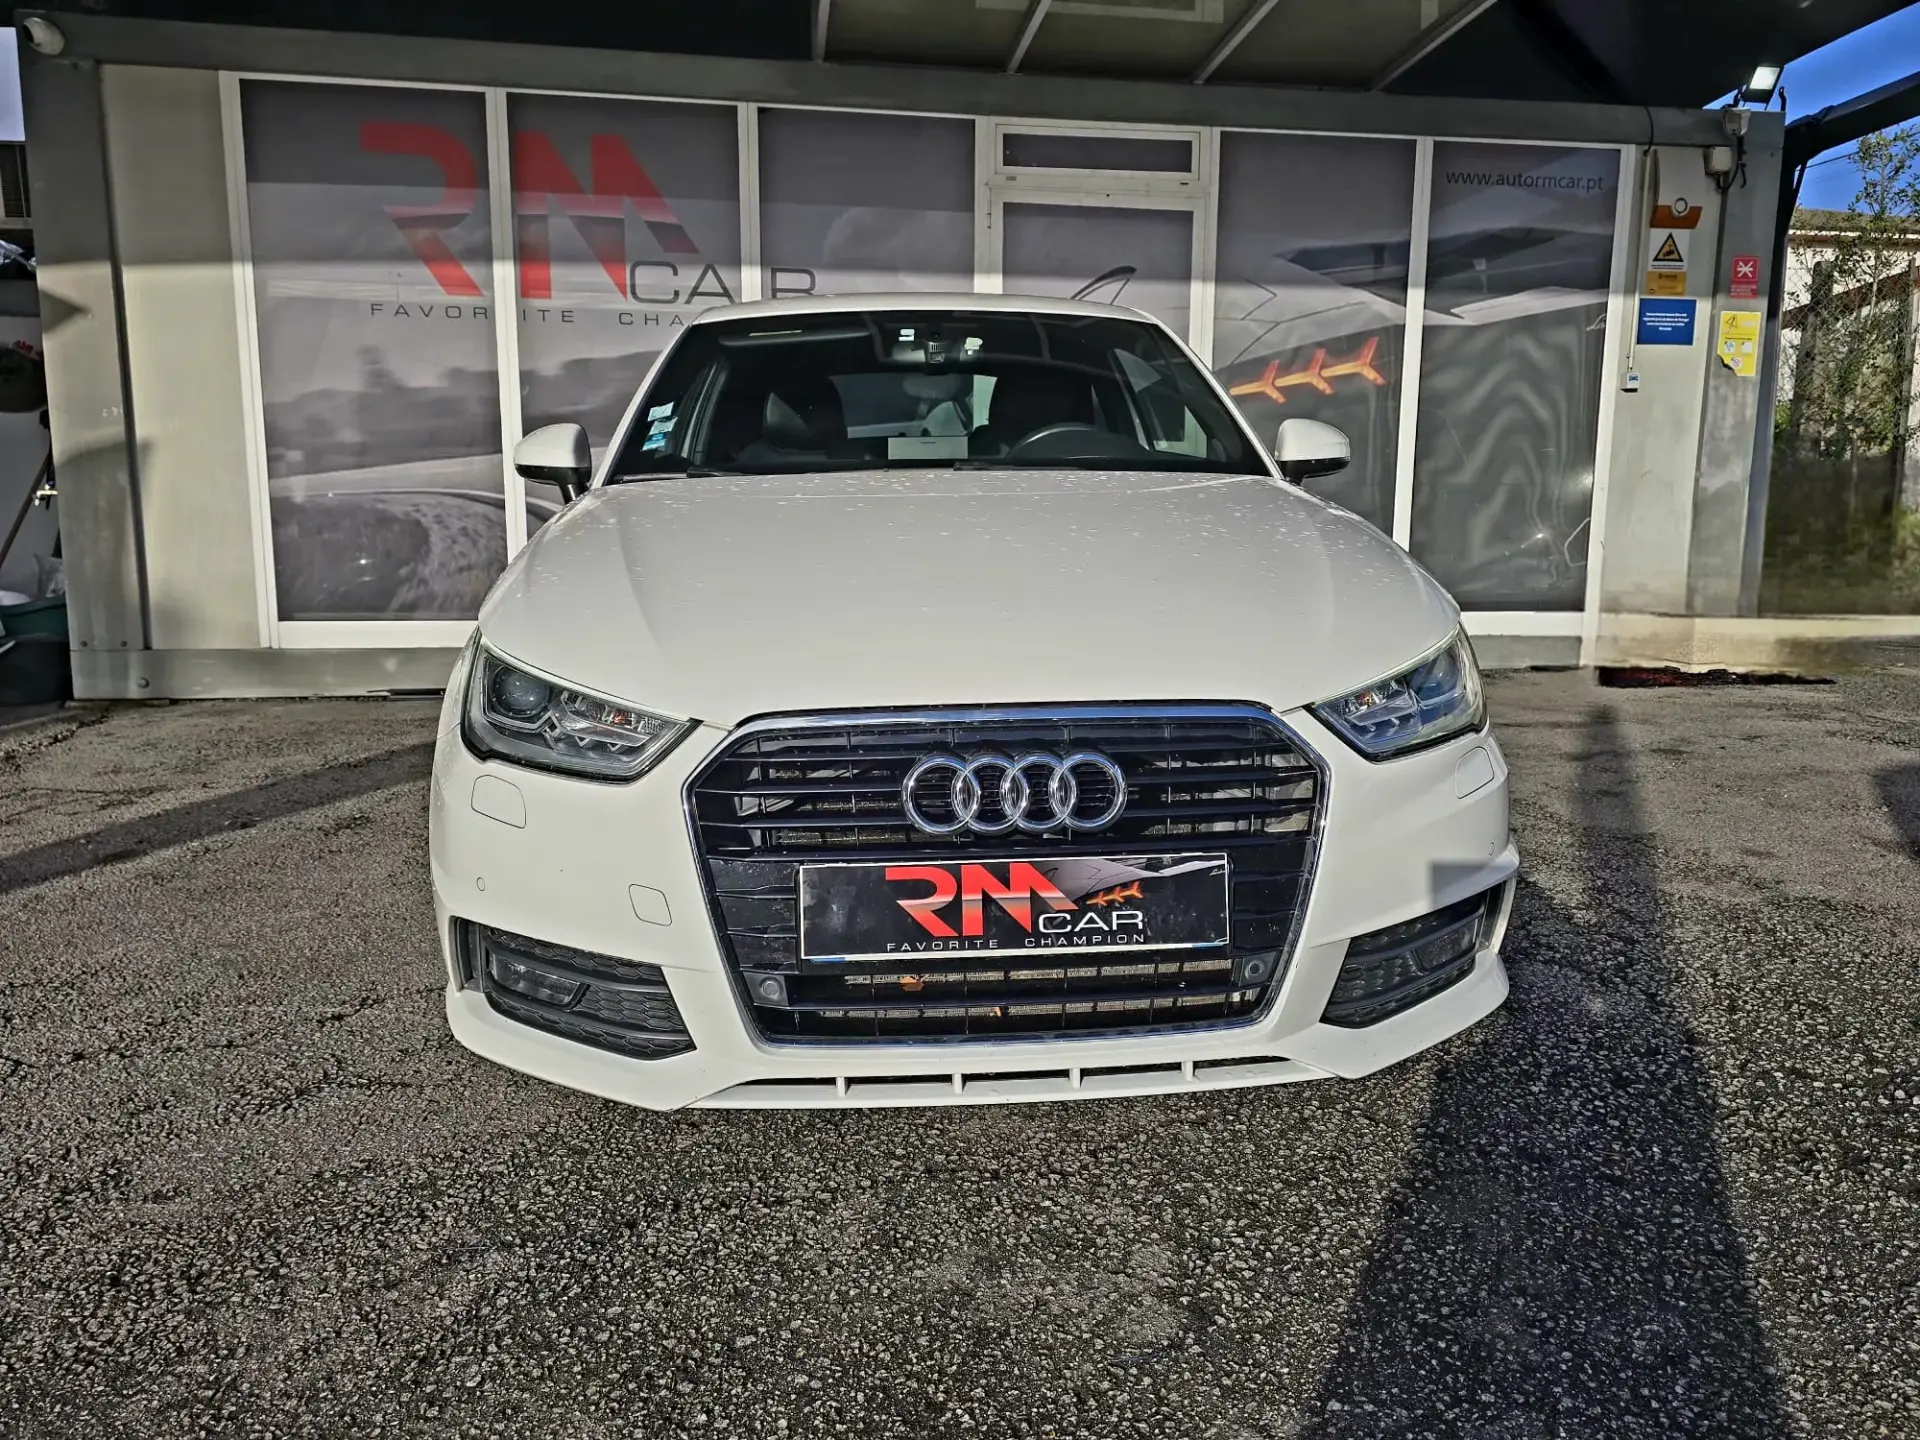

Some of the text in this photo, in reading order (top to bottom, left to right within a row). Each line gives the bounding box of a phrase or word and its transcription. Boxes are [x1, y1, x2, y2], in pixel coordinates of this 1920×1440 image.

[1446, 171, 1605, 193] www.autormcar.pt
[360, 121, 699, 303] RM
[370, 303, 575, 324] FAVORITE
[885, 861, 1144, 937] RM CAR
[887, 934, 1145, 952] FAVORITE CHAMPION
